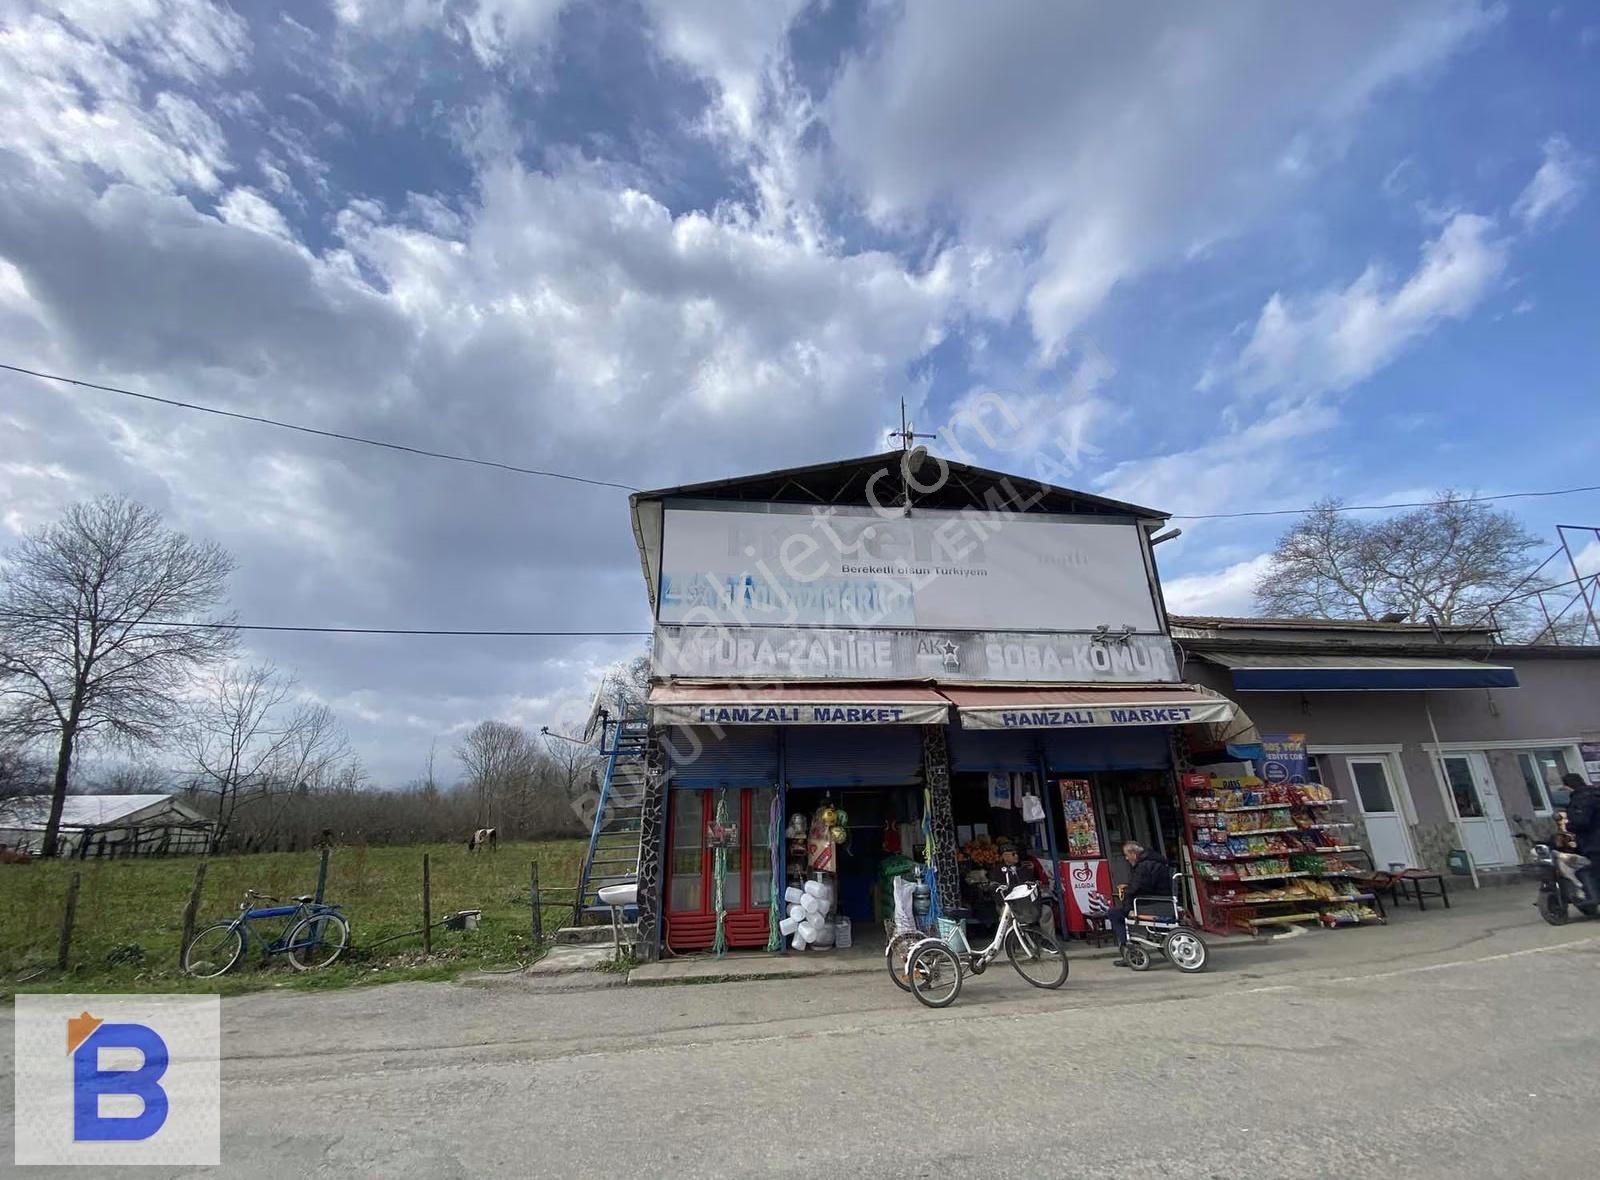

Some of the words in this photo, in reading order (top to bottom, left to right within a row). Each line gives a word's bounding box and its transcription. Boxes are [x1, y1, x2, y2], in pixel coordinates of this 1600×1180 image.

[842, 564, 894, 574] Bereketli
[897, 565, 930, 575] olsun
[700, 708, 799, 723] HAMZALI
[814, 708, 903, 722] MARKET
[1002, 710, 1094, 727] HAMZALI
[1110, 707, 1192, 724] MARKET
